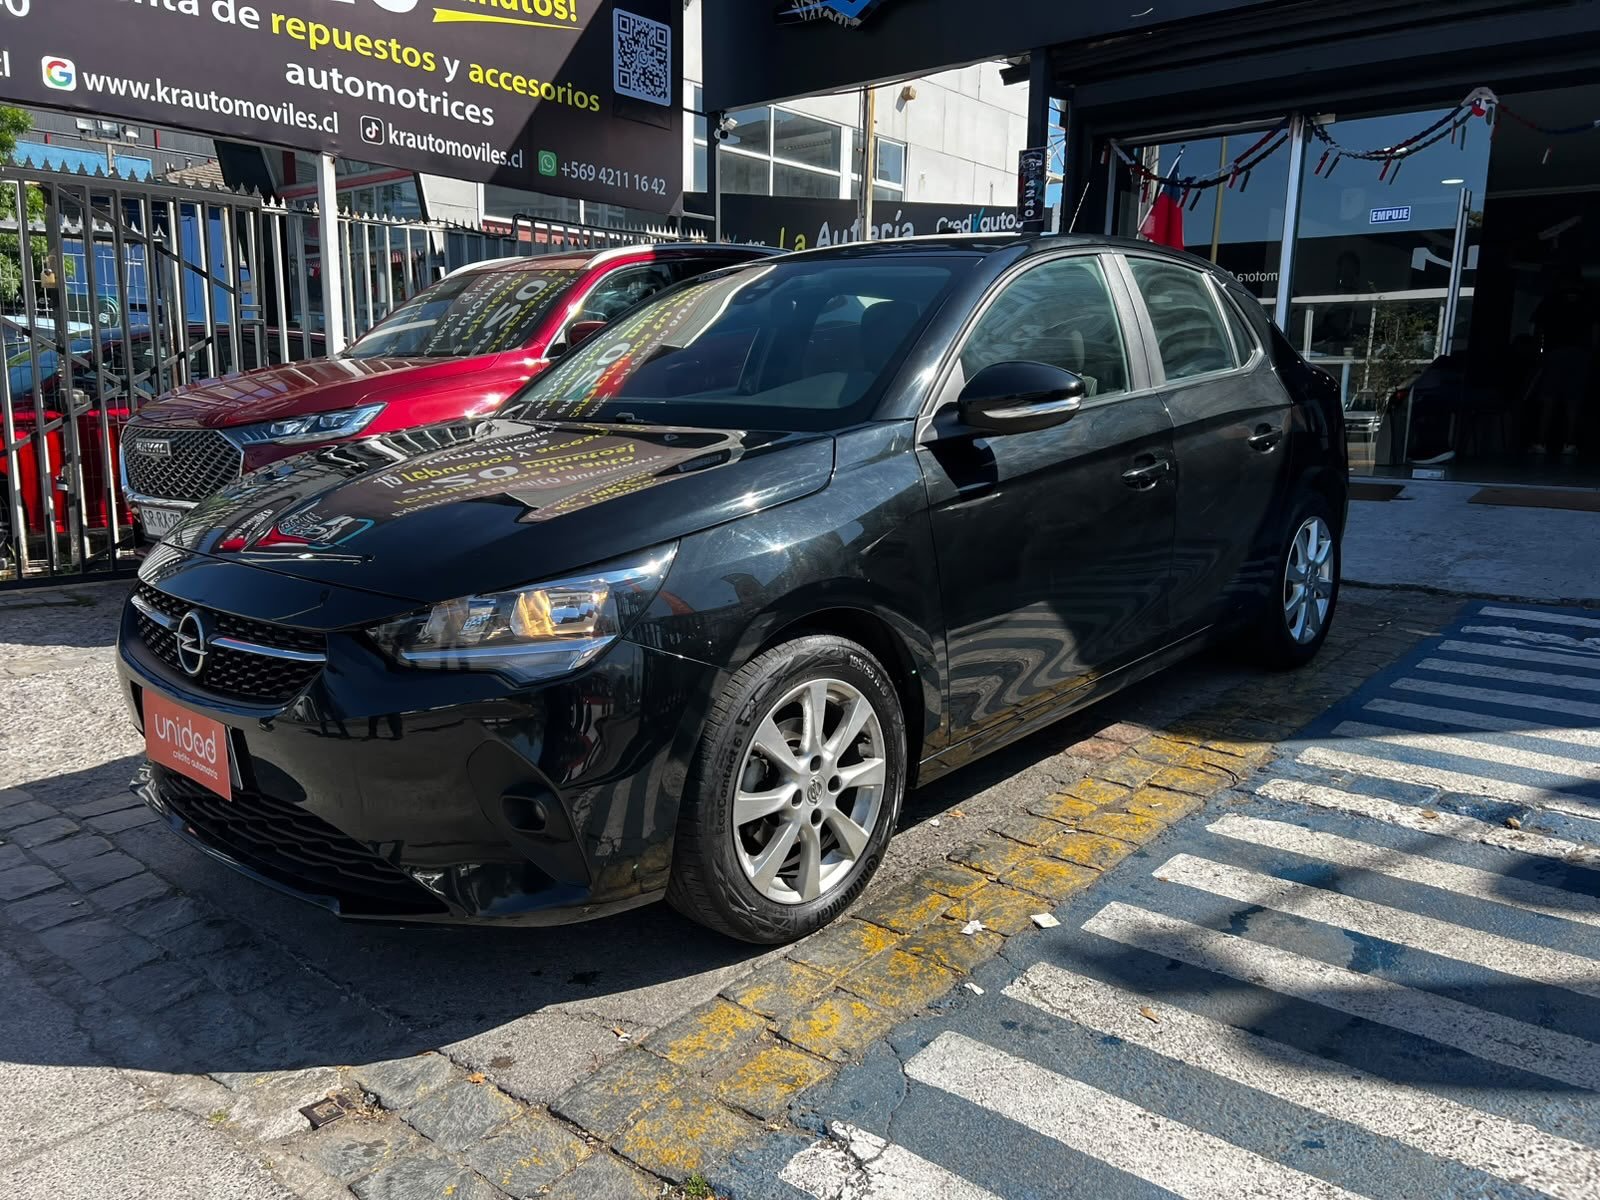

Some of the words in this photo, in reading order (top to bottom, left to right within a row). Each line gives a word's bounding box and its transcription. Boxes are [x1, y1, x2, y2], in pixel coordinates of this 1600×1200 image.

[272, 12, 439, 72] repuestos
[442, 56, 460, 83] y
[469, 62, 601, 113] accesorios
[82, 71, 339, 134] www.krautomoviles.cl
[285, 62, 495, 127] automotrices
[388, 122, 523, 169] krautomoviles.cl
[561, 161, 596, 181] +569
[598, 167, 630, 188] 4211
[634, 174, 649, 192] 16
[651, 177, 667, 195] 42
[1372, 208, 1409, 221] EMPUJE
[154, 713, 217, 765] unidad
